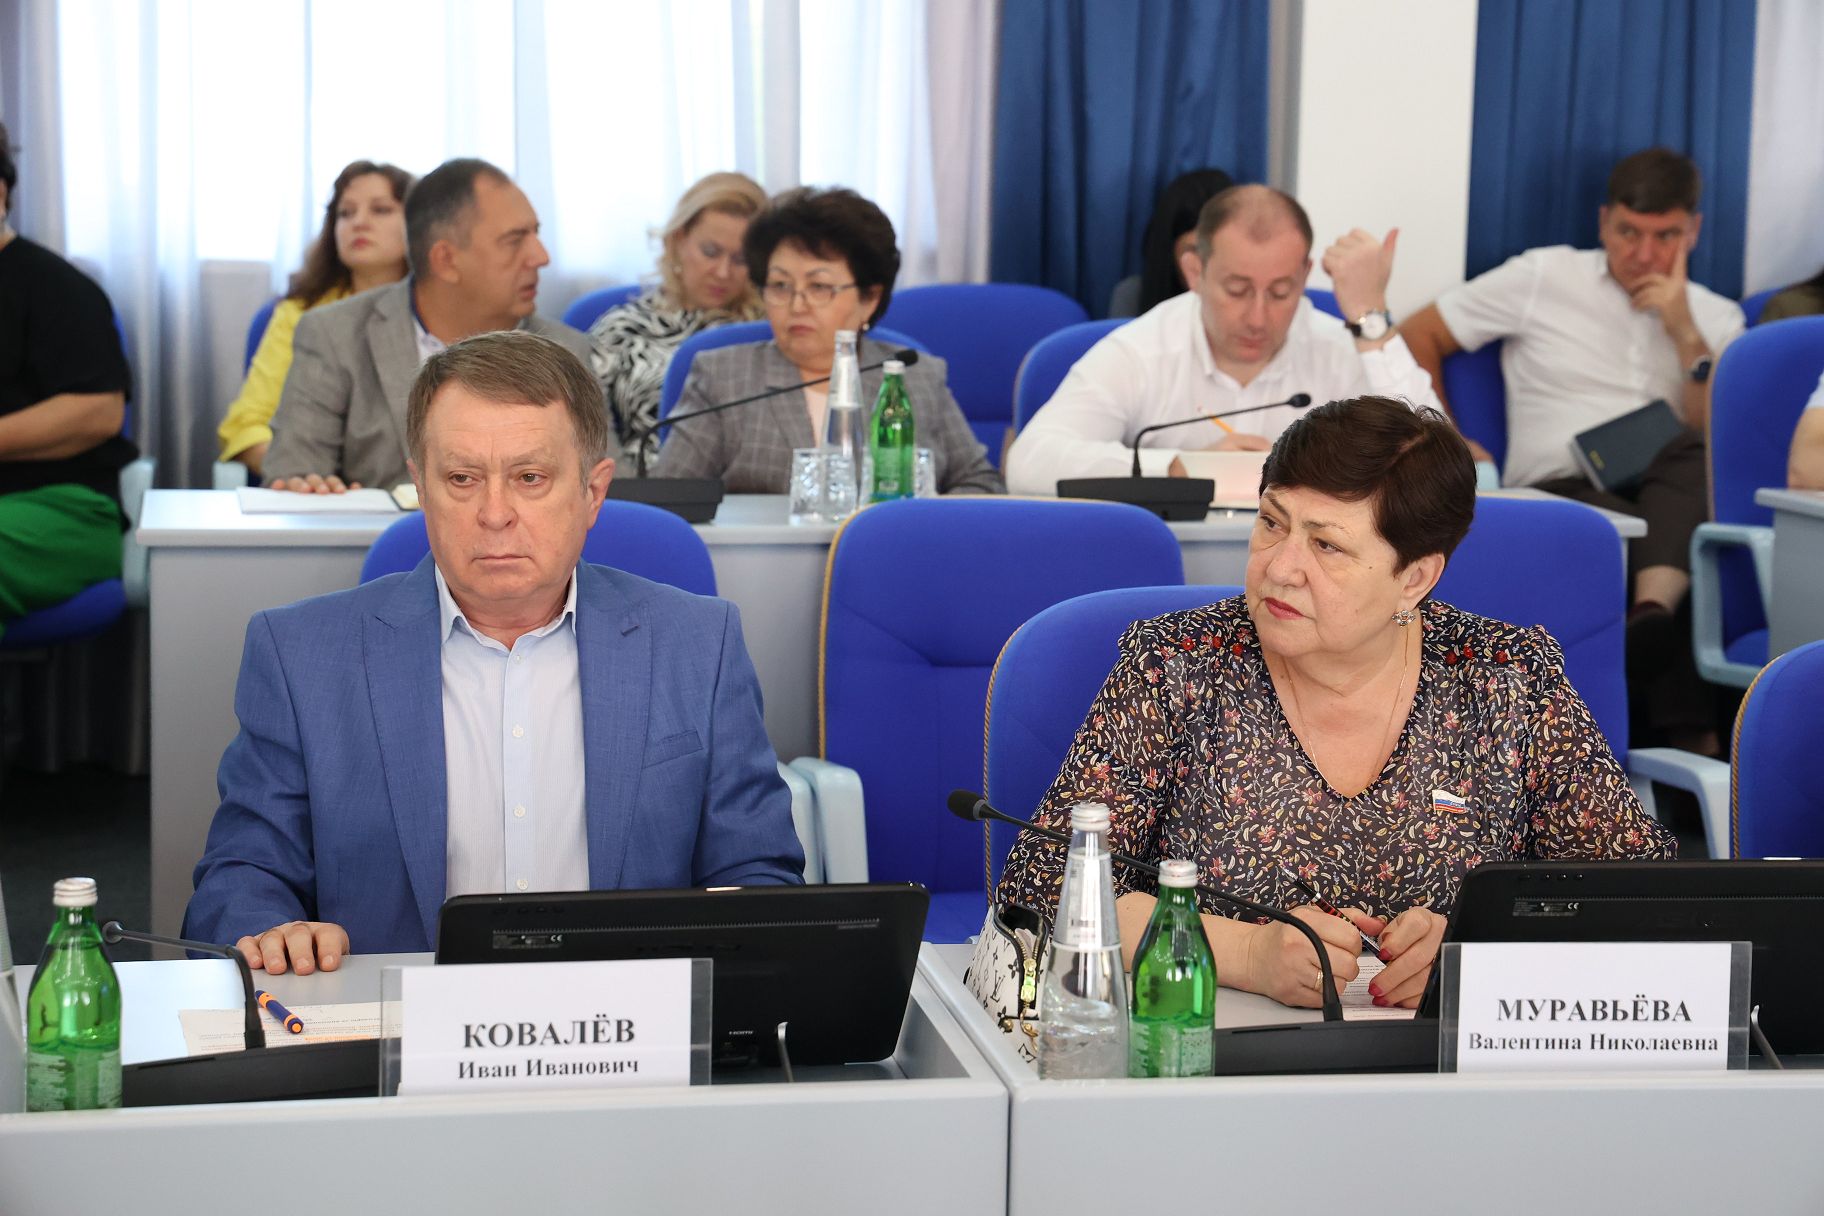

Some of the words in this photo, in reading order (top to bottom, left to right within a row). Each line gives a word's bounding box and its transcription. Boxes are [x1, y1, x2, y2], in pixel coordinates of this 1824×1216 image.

[1497, 994, 1692, 1022] МУРАВЬЁВА
[463, 1013, 636, 1049] КОВАЛЁВ
[1468, 1033, 1582, 1050] Валентина
[1589, 1033, 1719, 1051] Николаевна
[458, 1061, 517, 1079] Иван
[526, 1058, 639, 1077] Иванович
